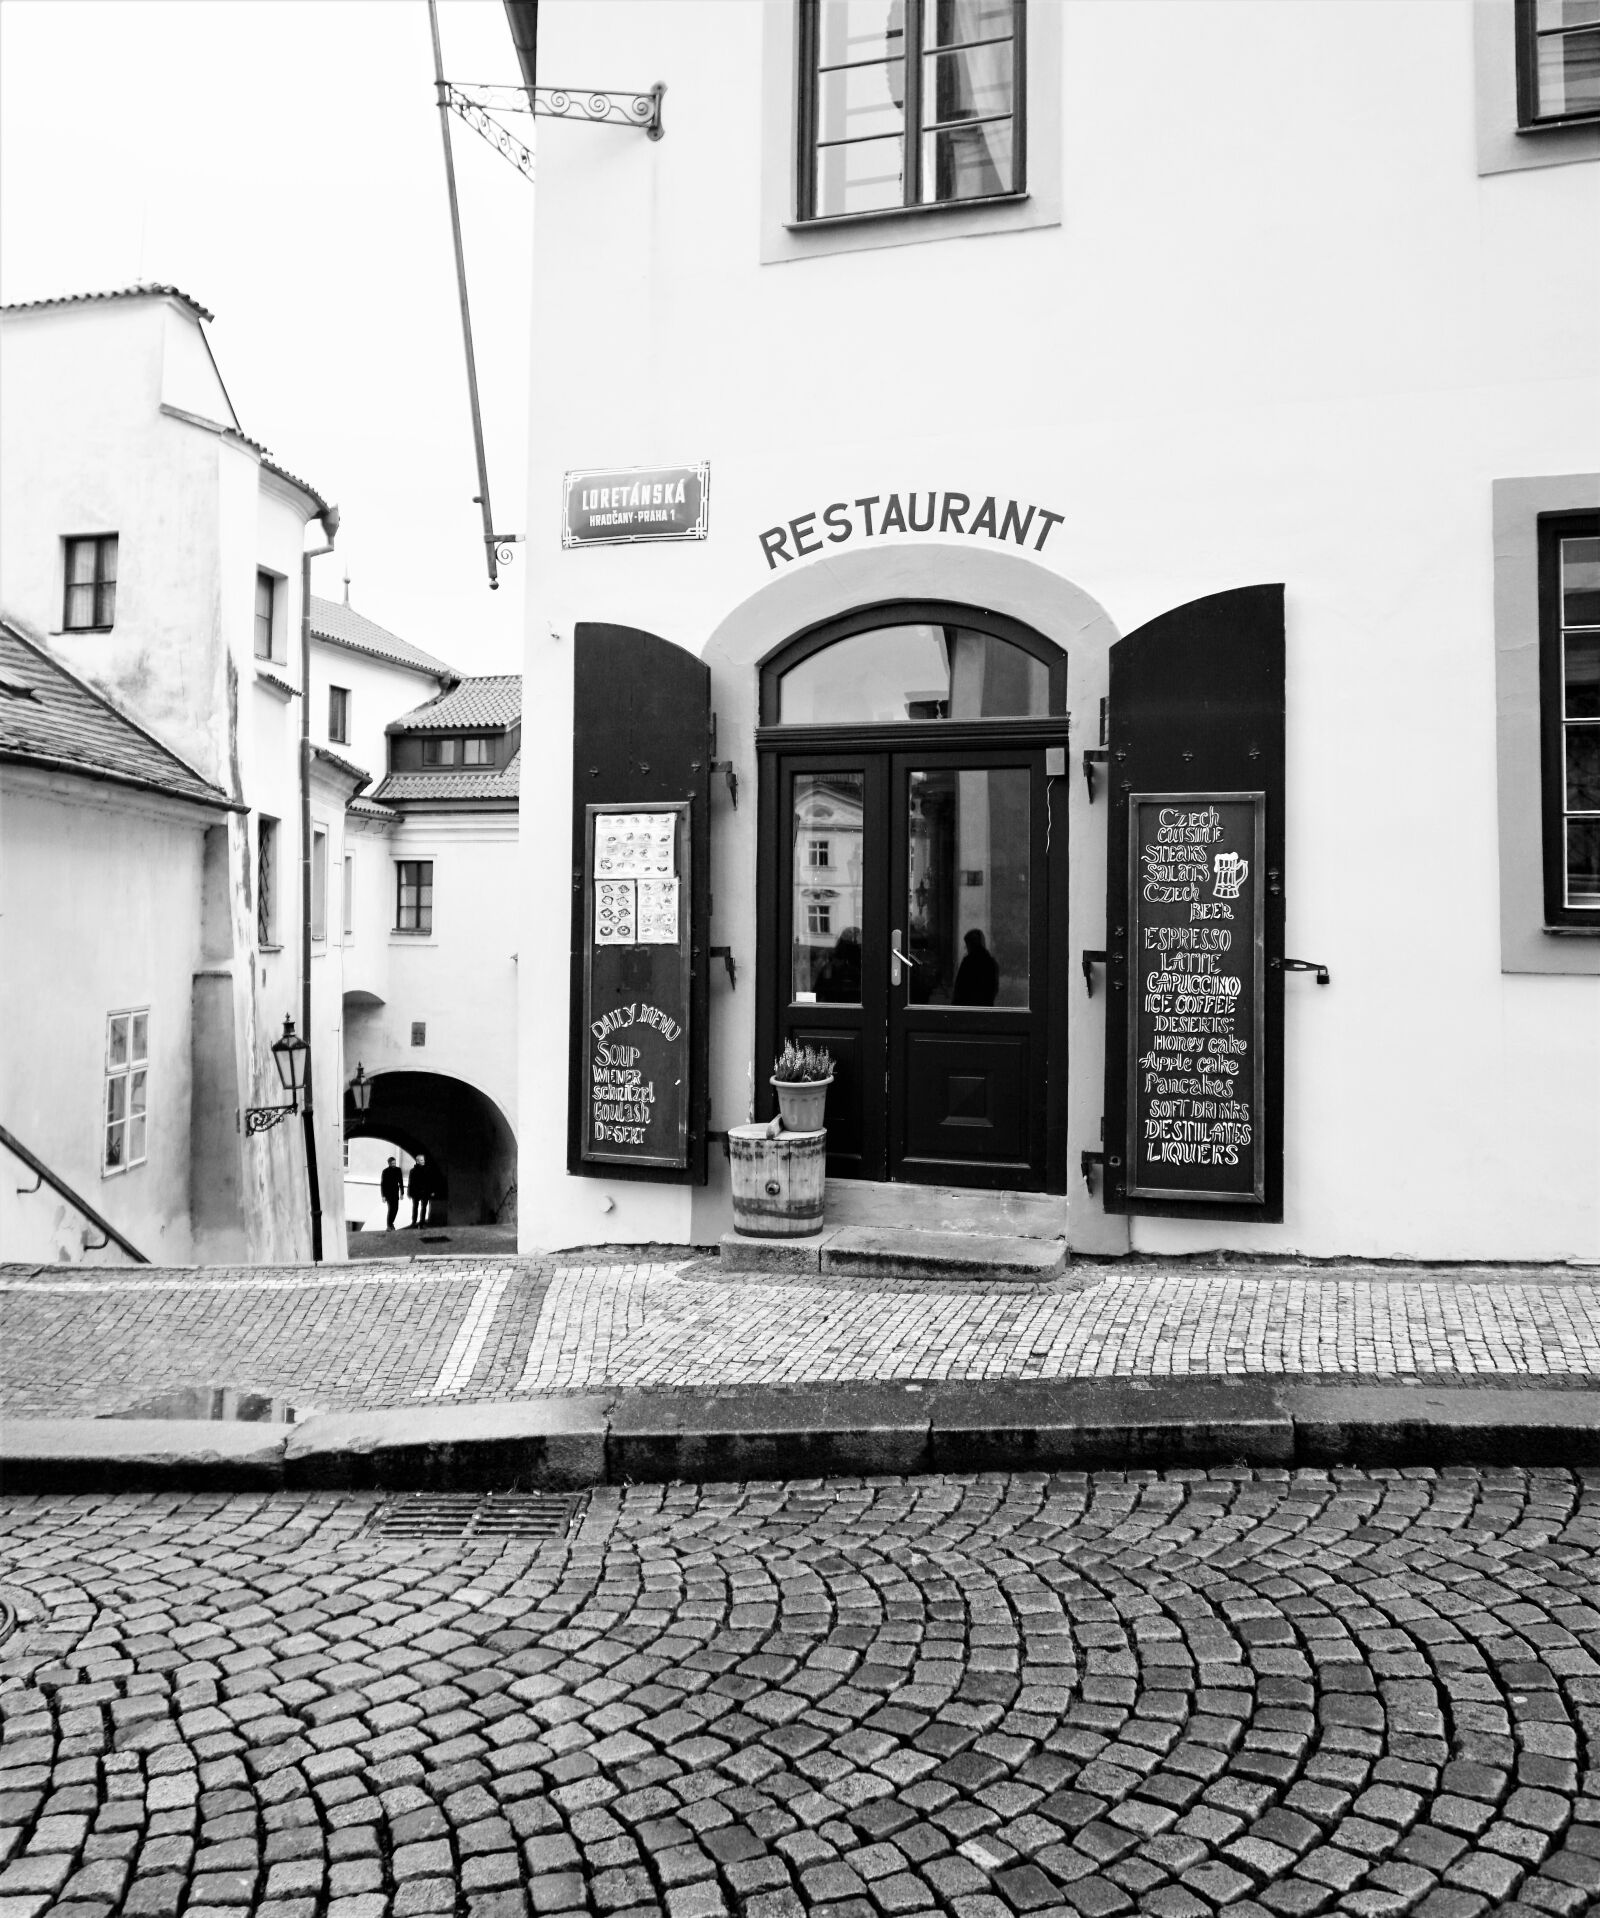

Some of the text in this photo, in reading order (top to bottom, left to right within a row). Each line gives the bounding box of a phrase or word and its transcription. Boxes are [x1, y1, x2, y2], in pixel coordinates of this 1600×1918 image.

[582, 478, 685, 511] LORETÁNSKÁ
[670, 509, 676, 521] 1
[758, 491, 1065, 570] RESTAURANT
[1144, 927, 1232, 951] ESPRESSO
[1160, 952, 1222, 973] LATTE
[1147, 972, 1242, 995] CAPUCCINO
[1145, 994, 1238, 1014] ICE COFFEE
[590, 1003, 682, 1042] DAILY MENU
[1149, 1099, 1190, 1118] SOFT
[1144, 1119, 1252, 1145] DESTILATES
[1146, 1142, 1239, 1165] LIQUERS
